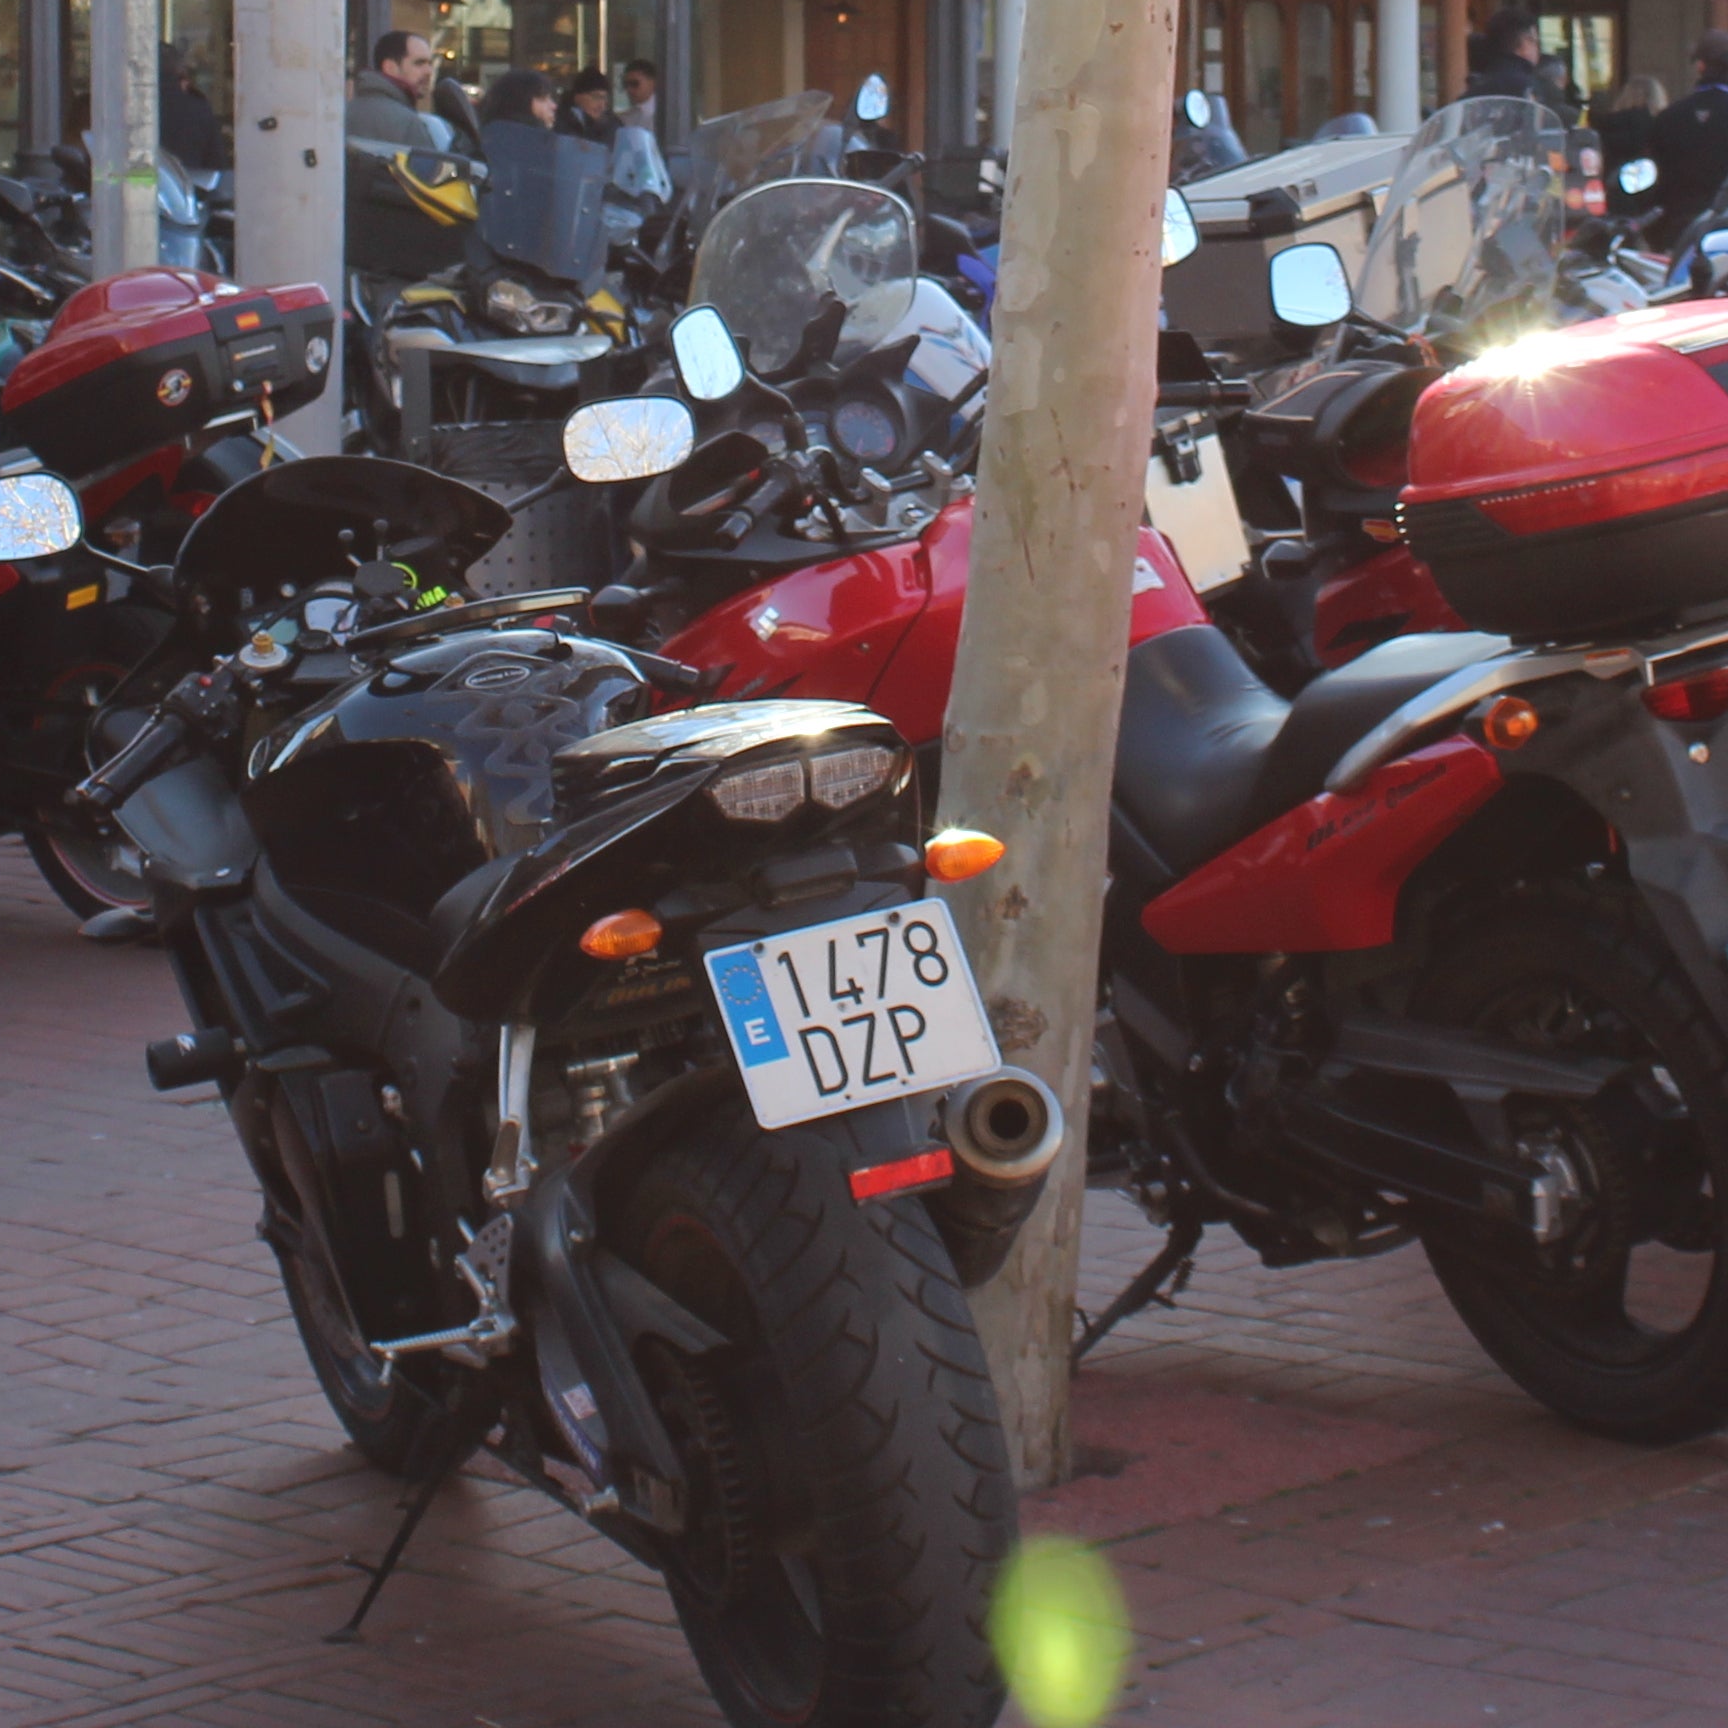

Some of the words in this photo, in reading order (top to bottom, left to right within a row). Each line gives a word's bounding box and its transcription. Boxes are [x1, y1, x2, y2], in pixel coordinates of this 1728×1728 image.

[777, 920, 949, 1019] 1478
[744, 1018, 771, 1047] E
[798, 1004, 927, 1099] DZP
